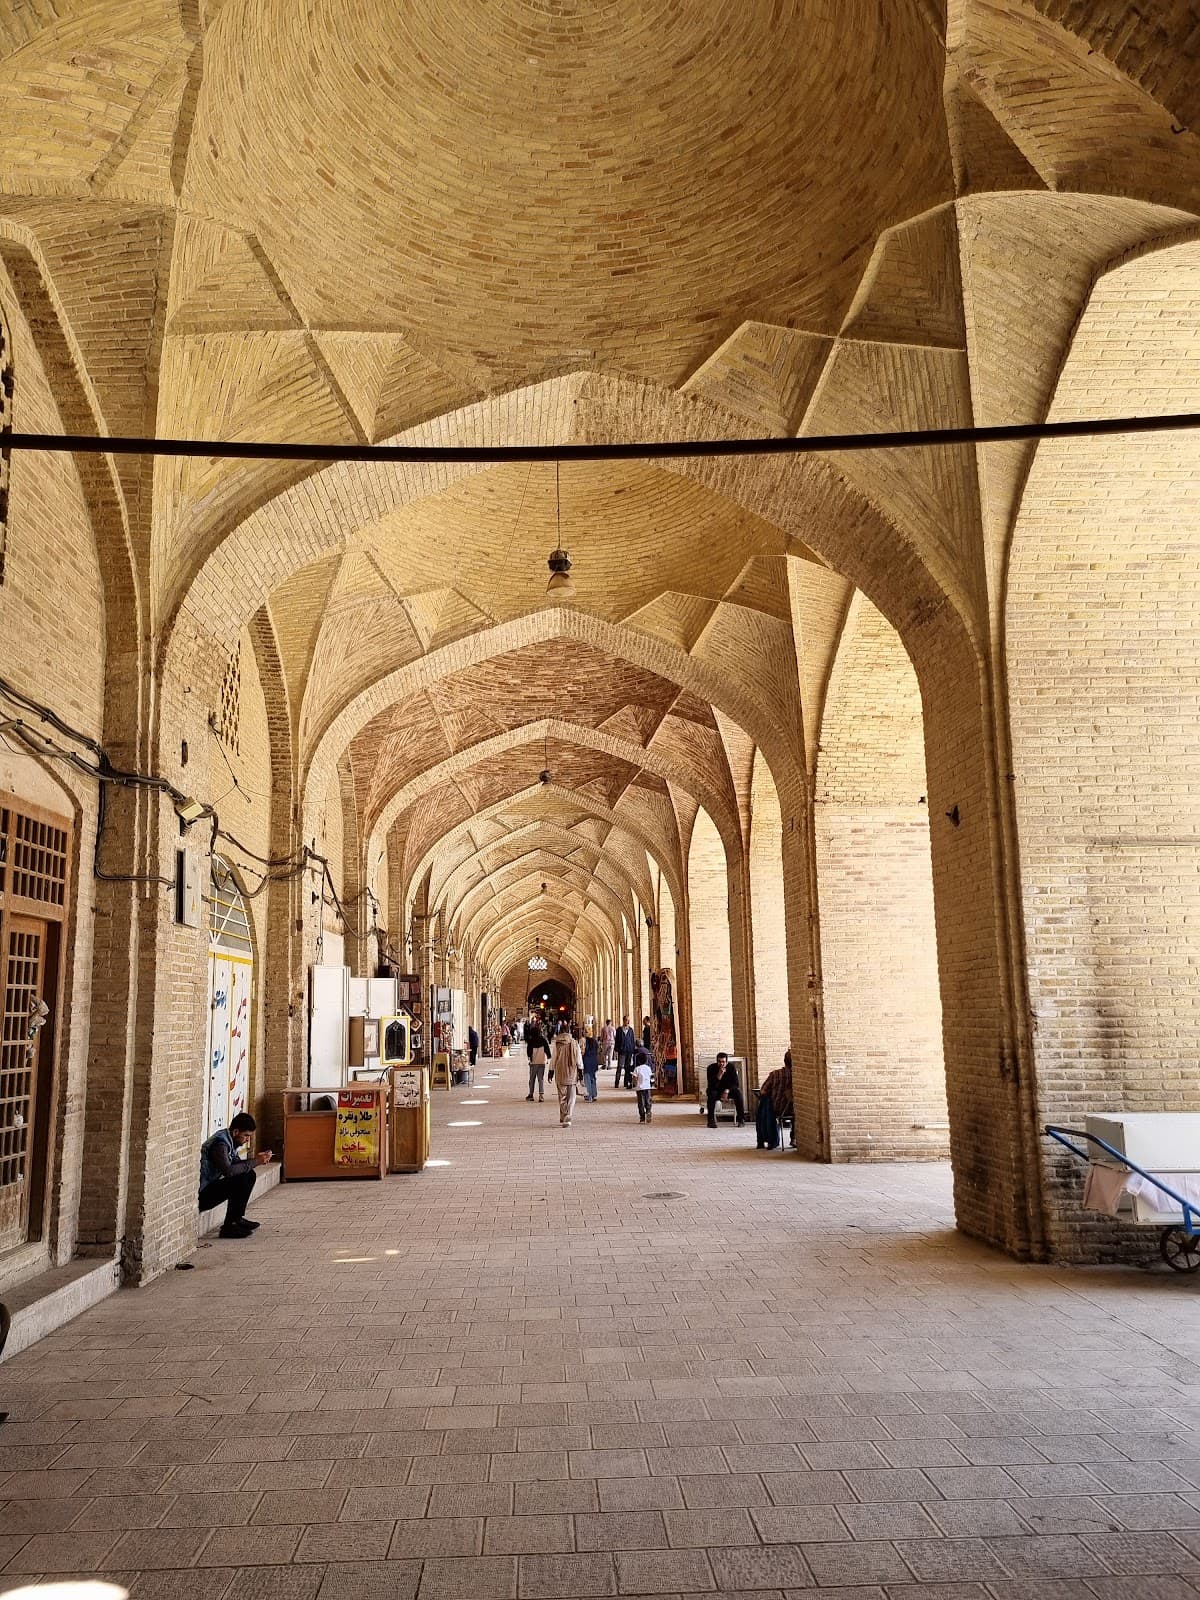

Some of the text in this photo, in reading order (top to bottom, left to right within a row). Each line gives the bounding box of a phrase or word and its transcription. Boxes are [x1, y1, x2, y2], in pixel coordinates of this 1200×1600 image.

[340, 1092, 372, 1106] تعمیرات
[360, 1110, 373, 1121] طلا
[342, 1141, 366, 1152] ساخت
